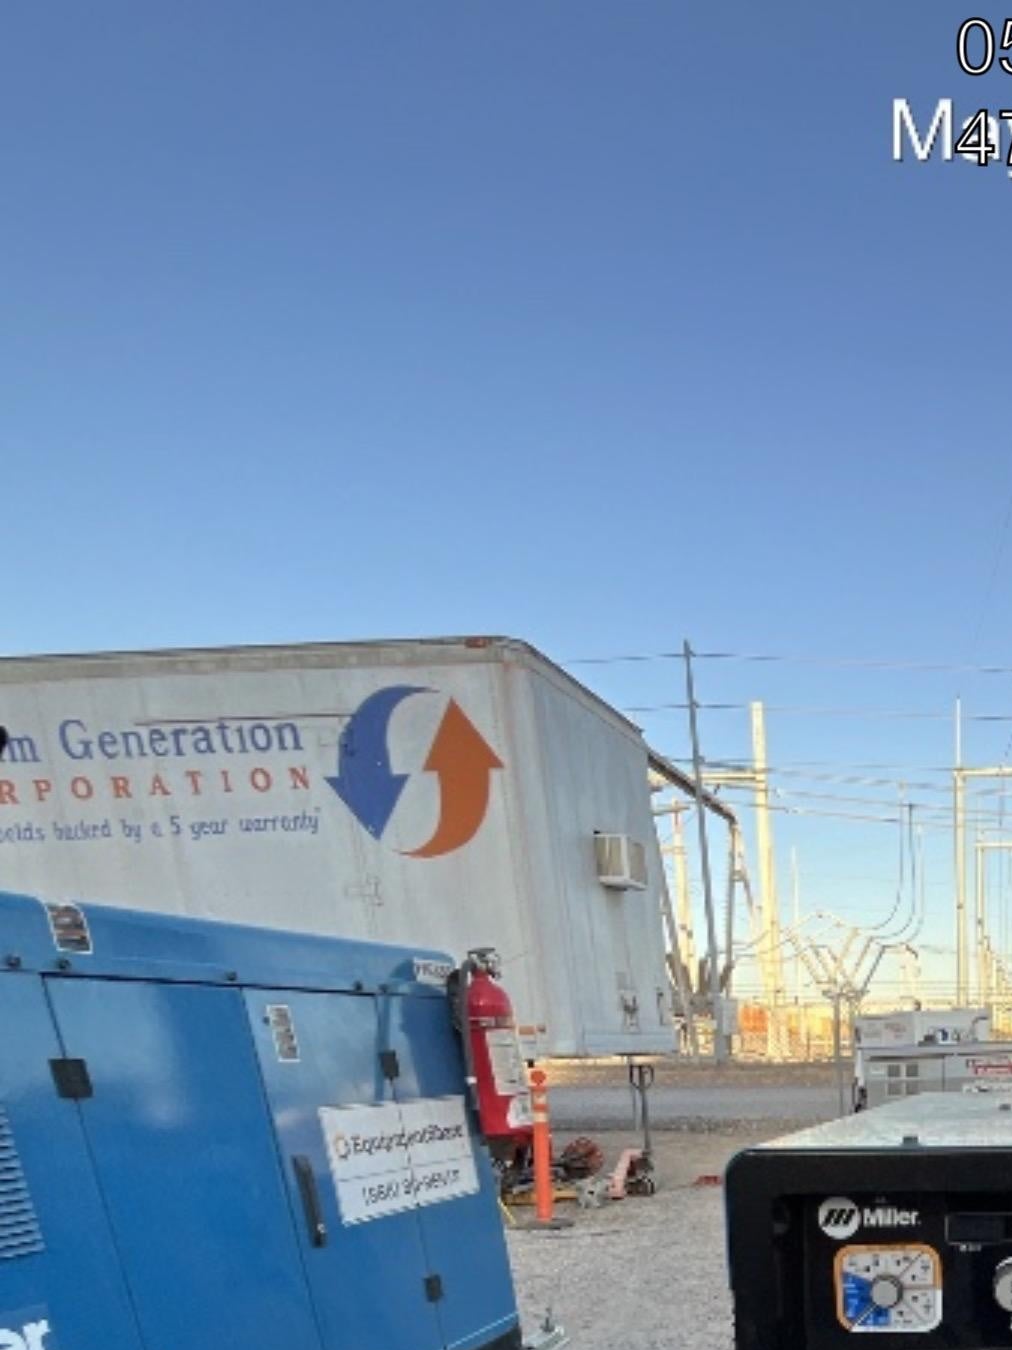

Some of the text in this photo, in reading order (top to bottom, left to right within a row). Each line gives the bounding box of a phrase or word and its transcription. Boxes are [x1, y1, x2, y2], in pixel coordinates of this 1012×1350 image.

[58, 718, 305, 761] Generation
[120, 818, 142, 843] by
[169, 815, 181, 836] 5
[190, 818, 229, 842] year
[863, 1207, 919, 1229] Miller
